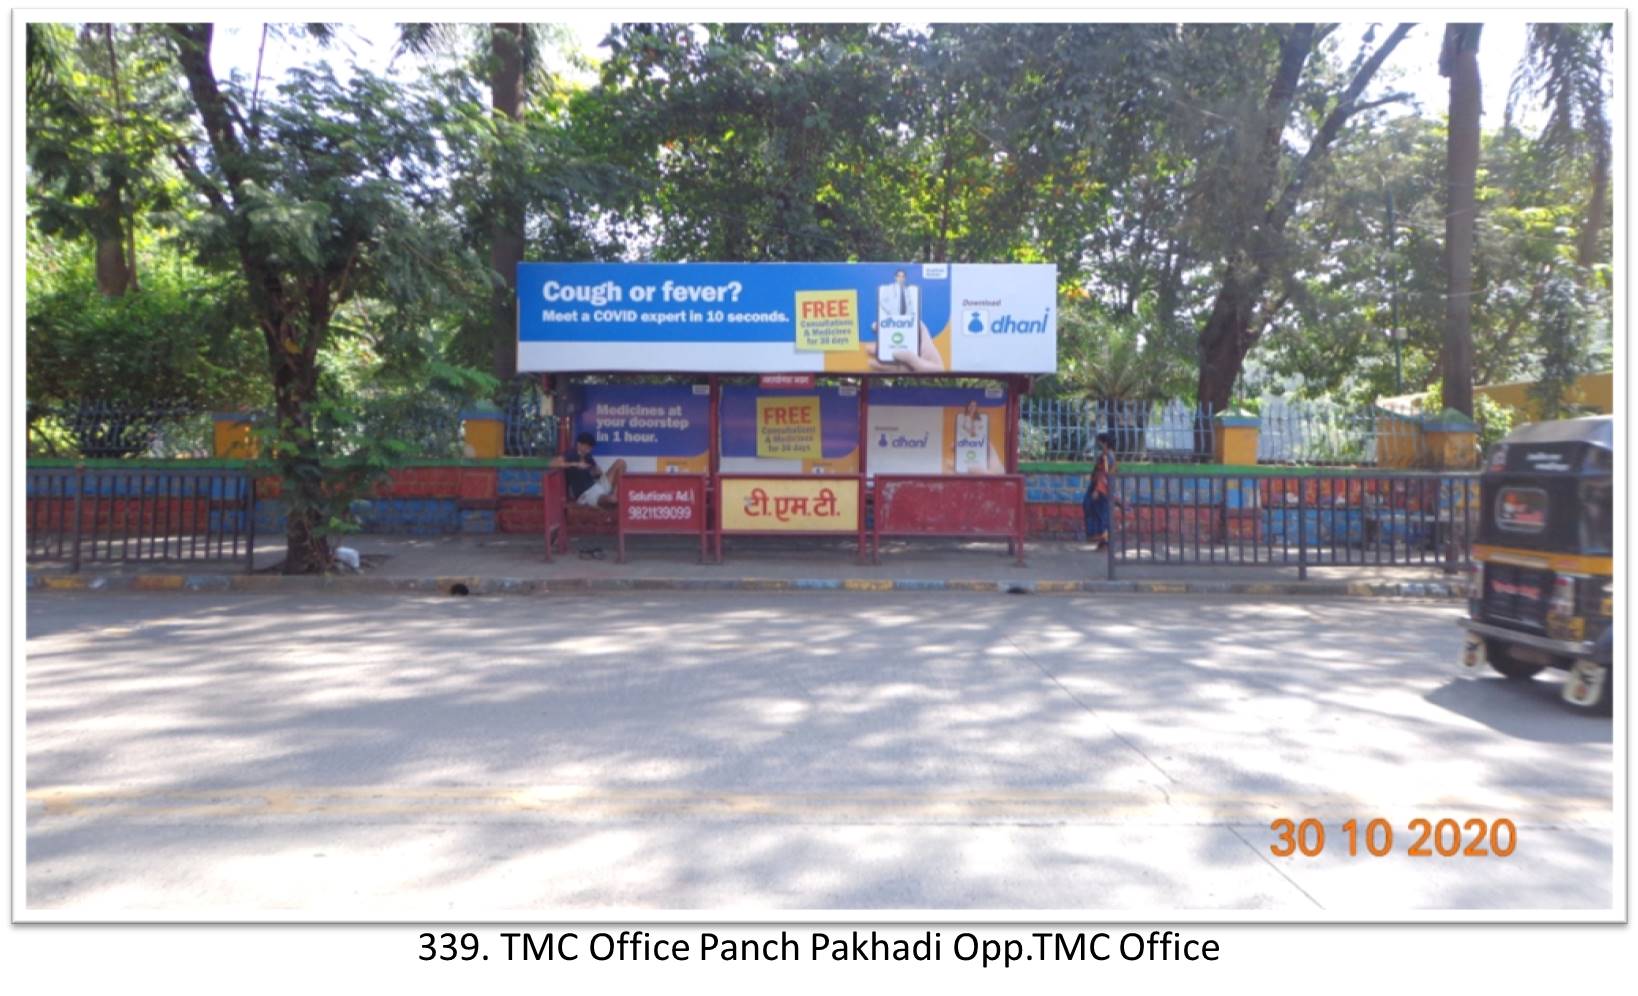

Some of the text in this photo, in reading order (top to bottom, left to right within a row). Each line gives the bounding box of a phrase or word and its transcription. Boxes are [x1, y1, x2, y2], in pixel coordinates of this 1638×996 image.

[542, 280, 743, 306] Cough or fever?
[542, 310, 790, 325] Meet a COVID expert in 10 seconds.
[802, 300, 849, 319] FREE
[880, 312, 915, 328] dhani
[991, 307, 1050, 333] dhani
[596, 404, 682, 416] Medicines at
[763, 407, 812, 425] FREE
[596, 417, 690, 431] your doorstep
[596, 431, 659, 443] in 1 hour.
[891, 432, 929, 448] dhani
[628, 506, 692, 520] 9821139099
